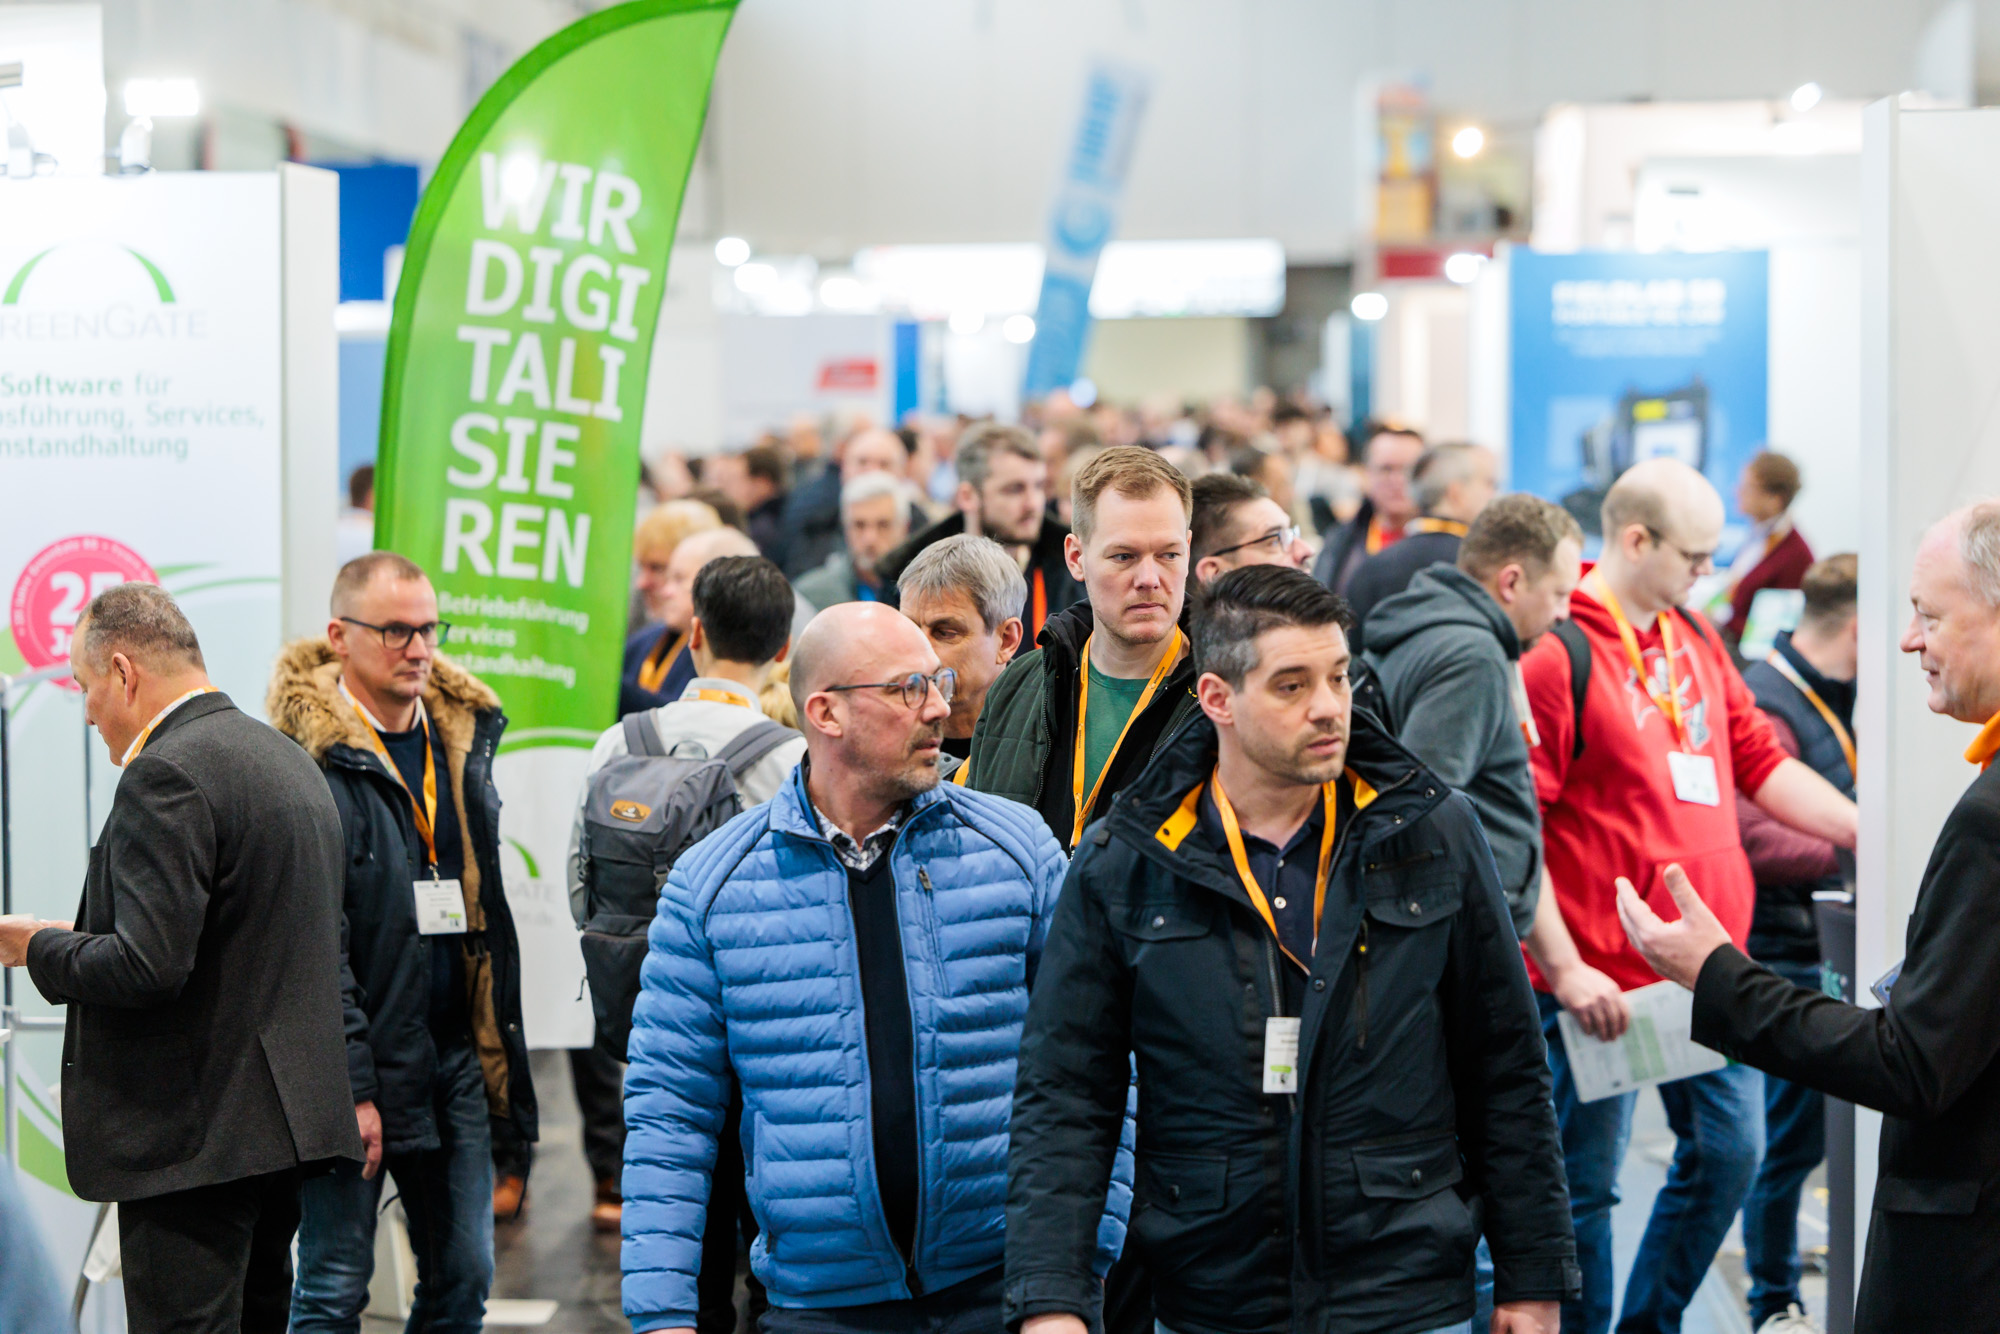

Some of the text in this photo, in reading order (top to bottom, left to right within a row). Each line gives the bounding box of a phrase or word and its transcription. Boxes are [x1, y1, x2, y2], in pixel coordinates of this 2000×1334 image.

[480, 152, 641, 255] WIR
[465, 238, 650, 342] DIGI
[0, 371, 173, 397] Software für
[146, 401, 265, 431] Services,
[457, 325, 626, 422] TALI
[447, 412, 581, 499] SIE
[441, 498, 592, 588] REN
[447, 623, 517, 648] ervices
